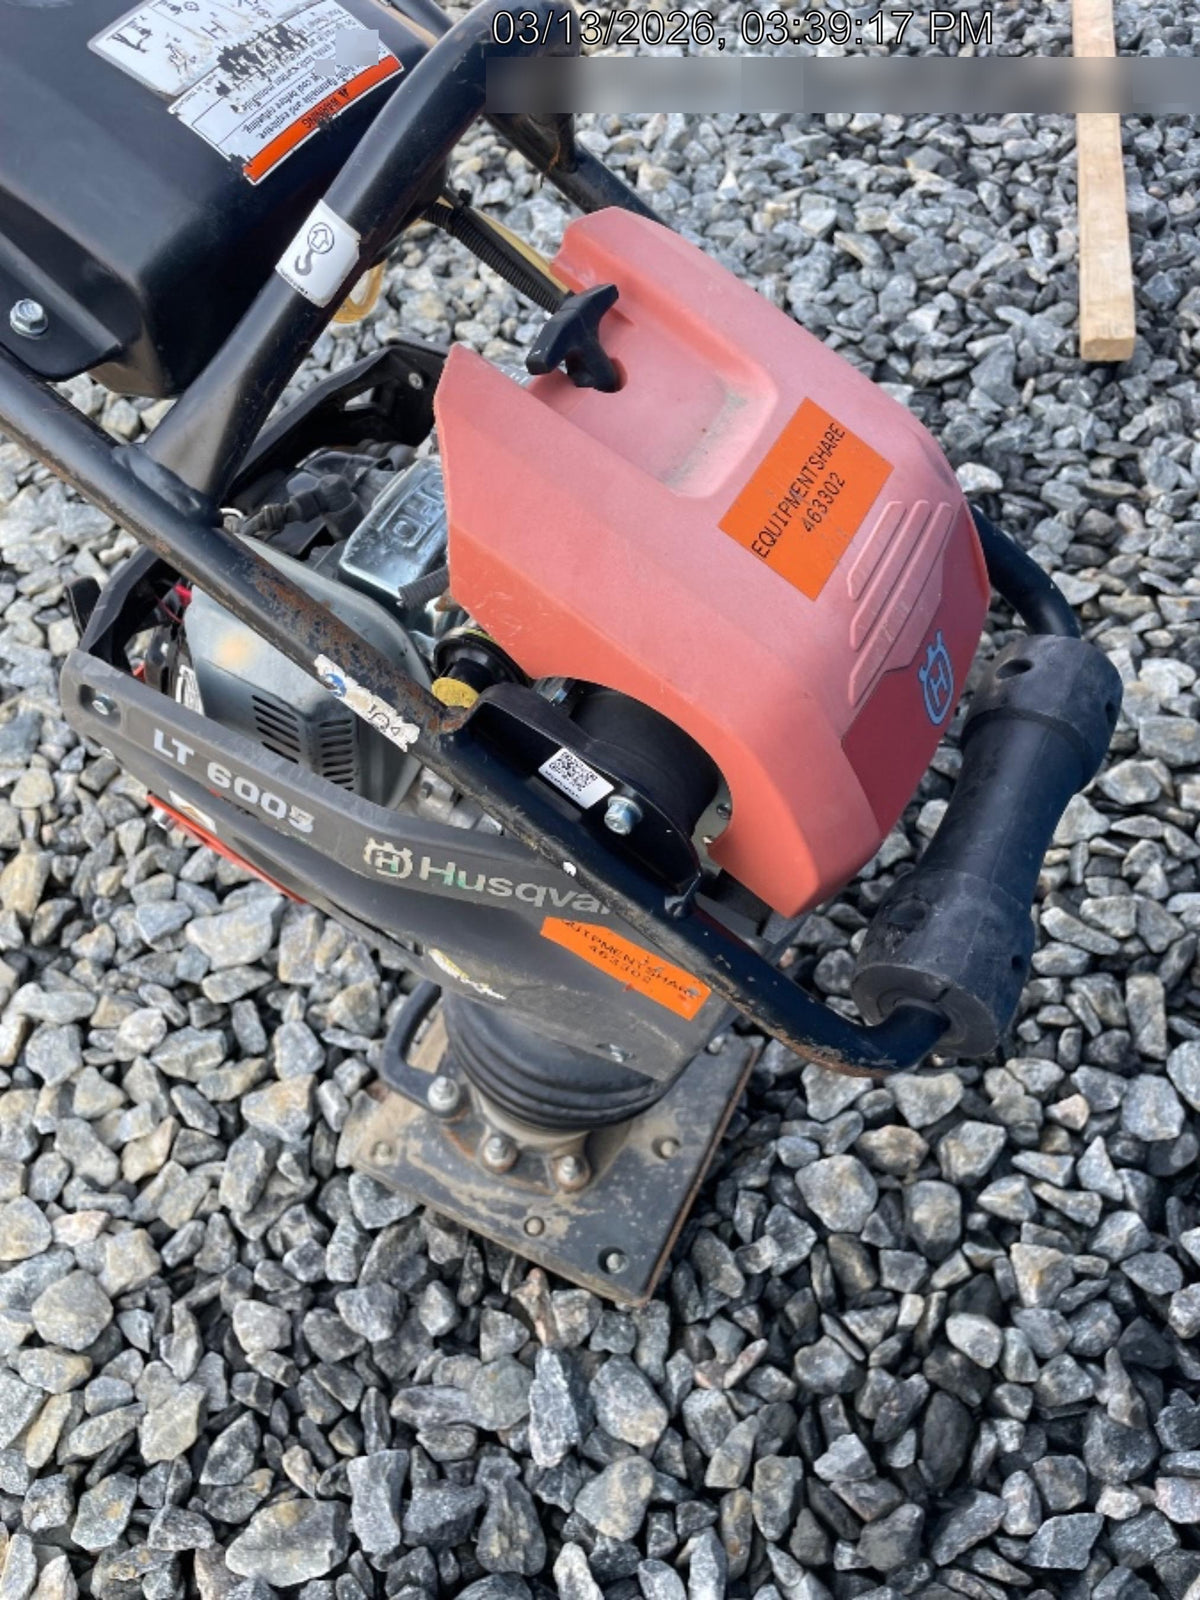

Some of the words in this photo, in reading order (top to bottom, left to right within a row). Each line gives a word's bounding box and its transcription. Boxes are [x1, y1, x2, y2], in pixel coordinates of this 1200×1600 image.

[302, 98, 340, 128] WARNING
[751, 422, 846, 559] EQUIPMENTSHARE
[803, 471, 845, 532] 463302
[154, 729, 194, 765] LT
[419, 856, 610, 915] Husqva
